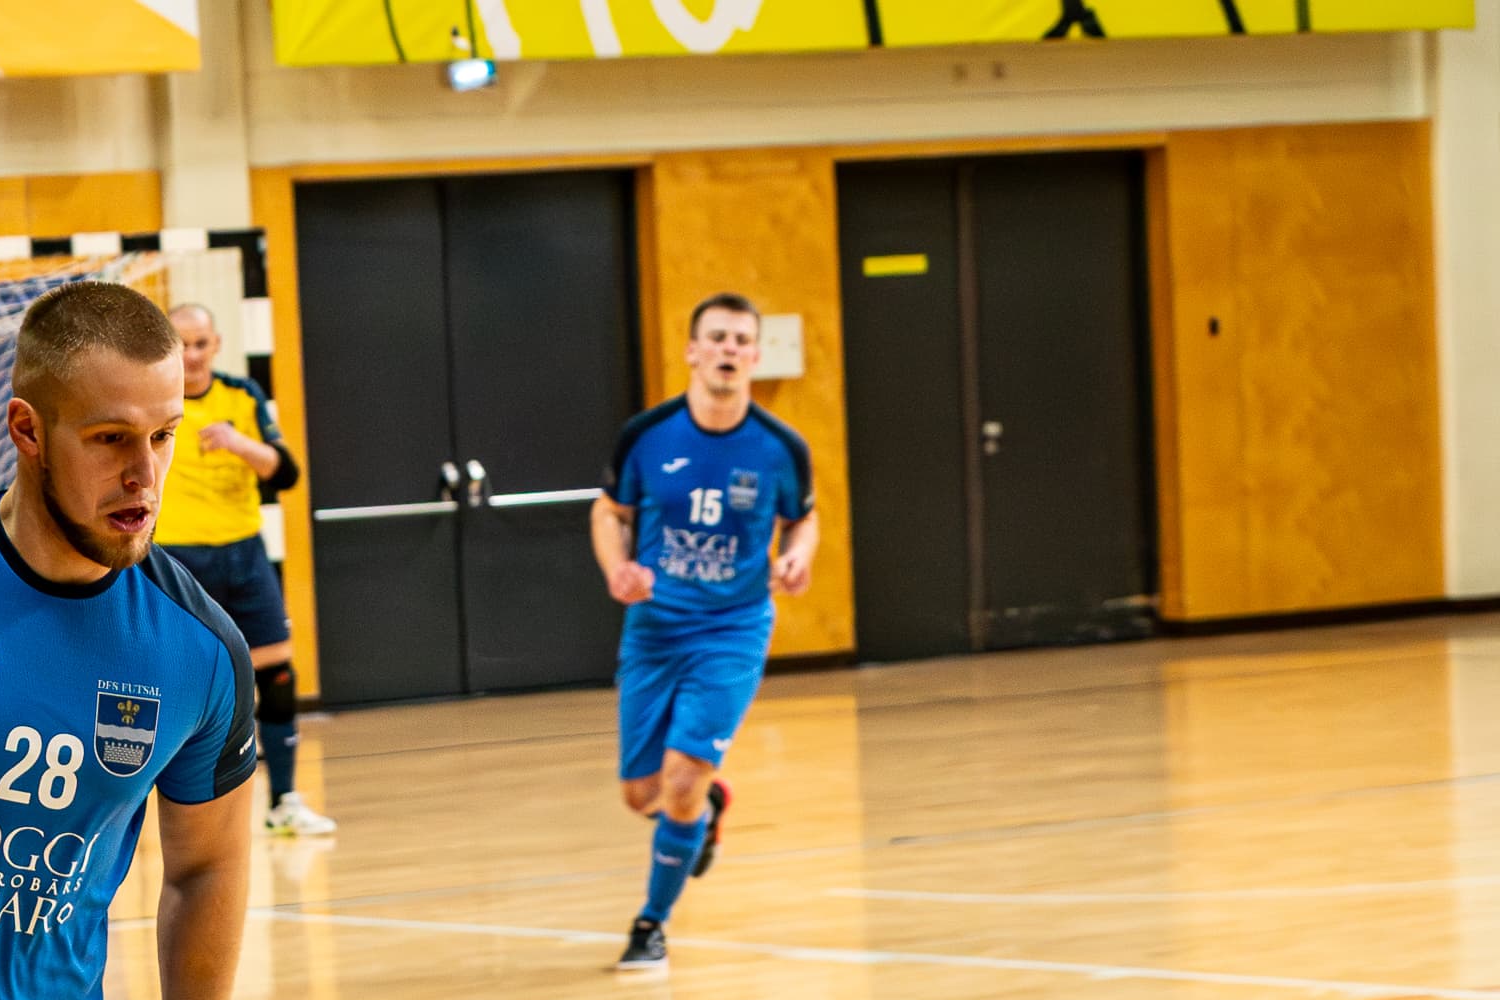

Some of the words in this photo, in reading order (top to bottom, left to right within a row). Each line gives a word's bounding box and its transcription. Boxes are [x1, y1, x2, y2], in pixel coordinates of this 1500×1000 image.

[689, 488, 723, 526] 15
[98, 679, 119, 691] DFS
[121, 682, 162, 697] FUTSAL
